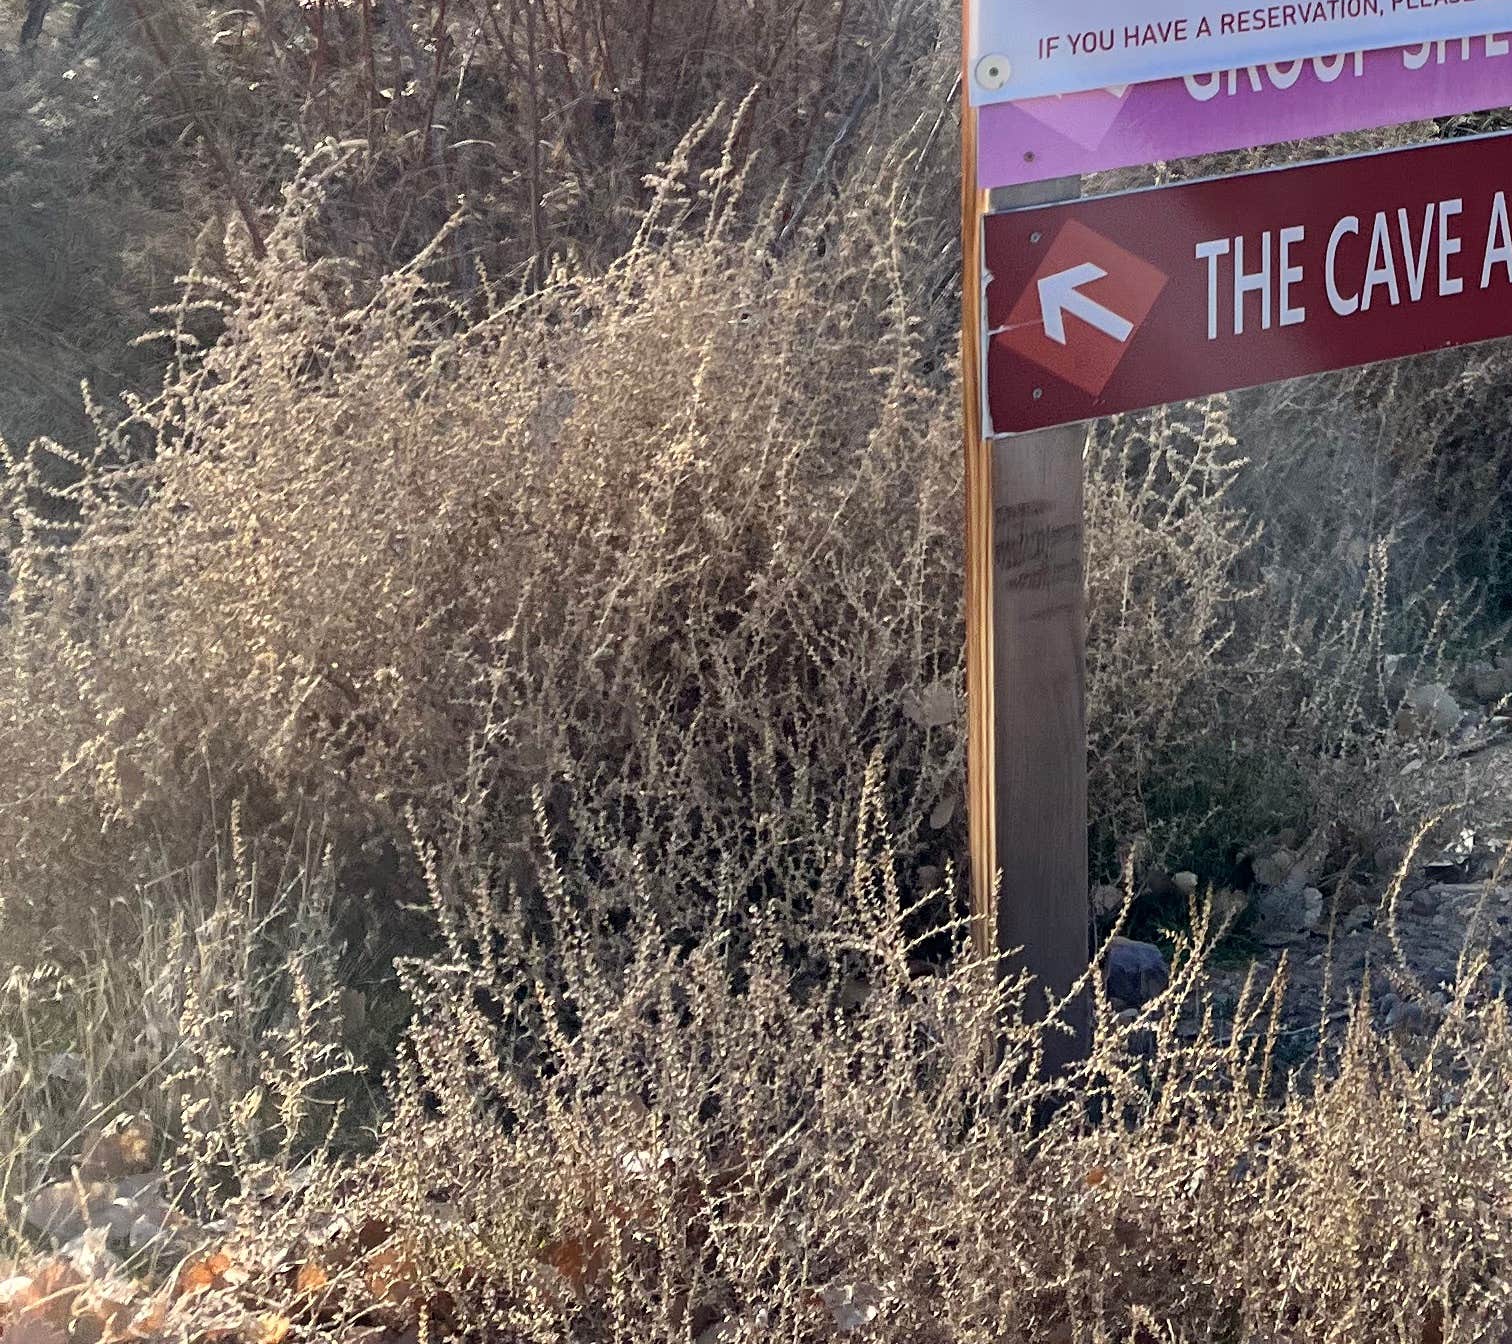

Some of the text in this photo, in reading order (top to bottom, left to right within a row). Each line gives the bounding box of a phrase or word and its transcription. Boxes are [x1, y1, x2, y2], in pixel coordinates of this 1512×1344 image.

[1040, 36, 1059, 59] IF
[1068, 29, 1114, 54] YOU
[1125, 19, 1187, 47] HAVE
[1196, 17, 1211, 38] A
[1196, 226, 1305, 339] THE
[1326, 199, 1463, 315] CAVE
